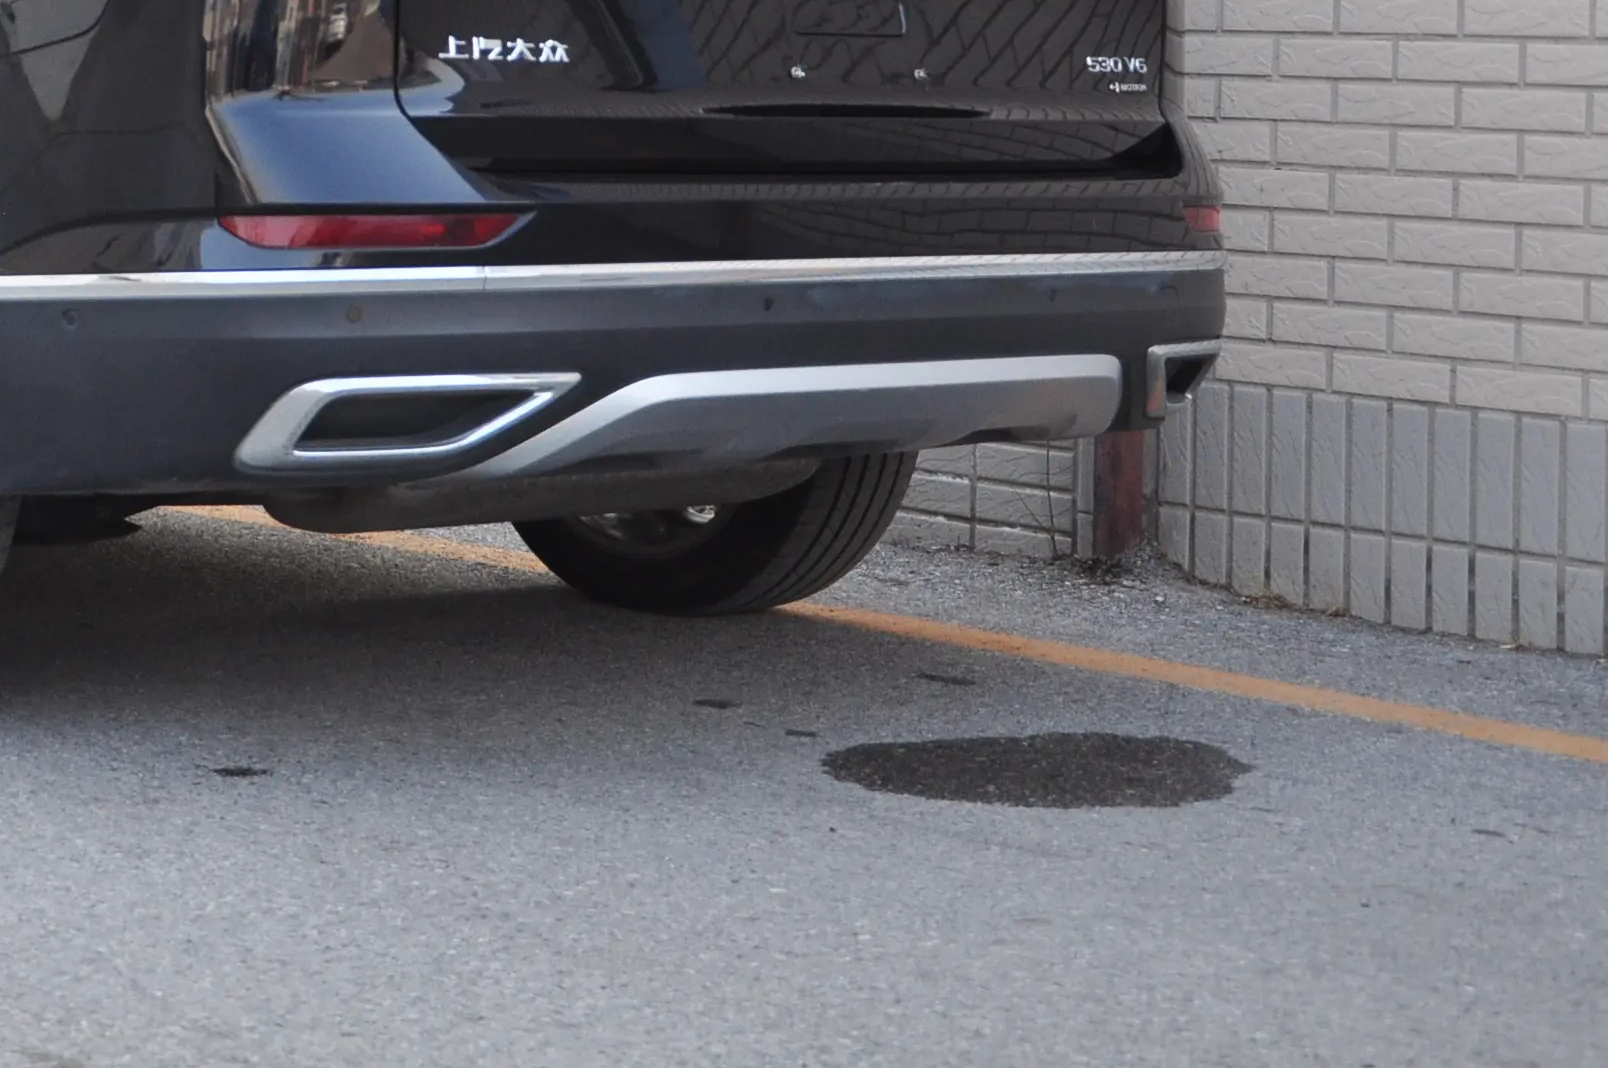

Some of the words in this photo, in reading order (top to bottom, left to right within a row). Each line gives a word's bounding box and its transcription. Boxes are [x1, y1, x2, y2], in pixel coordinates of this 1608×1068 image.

[438, 35, 570, 63] 上汽大众
[1085, 56, 1123, 73] 530
[1123, 56, 1148, 74] V6
